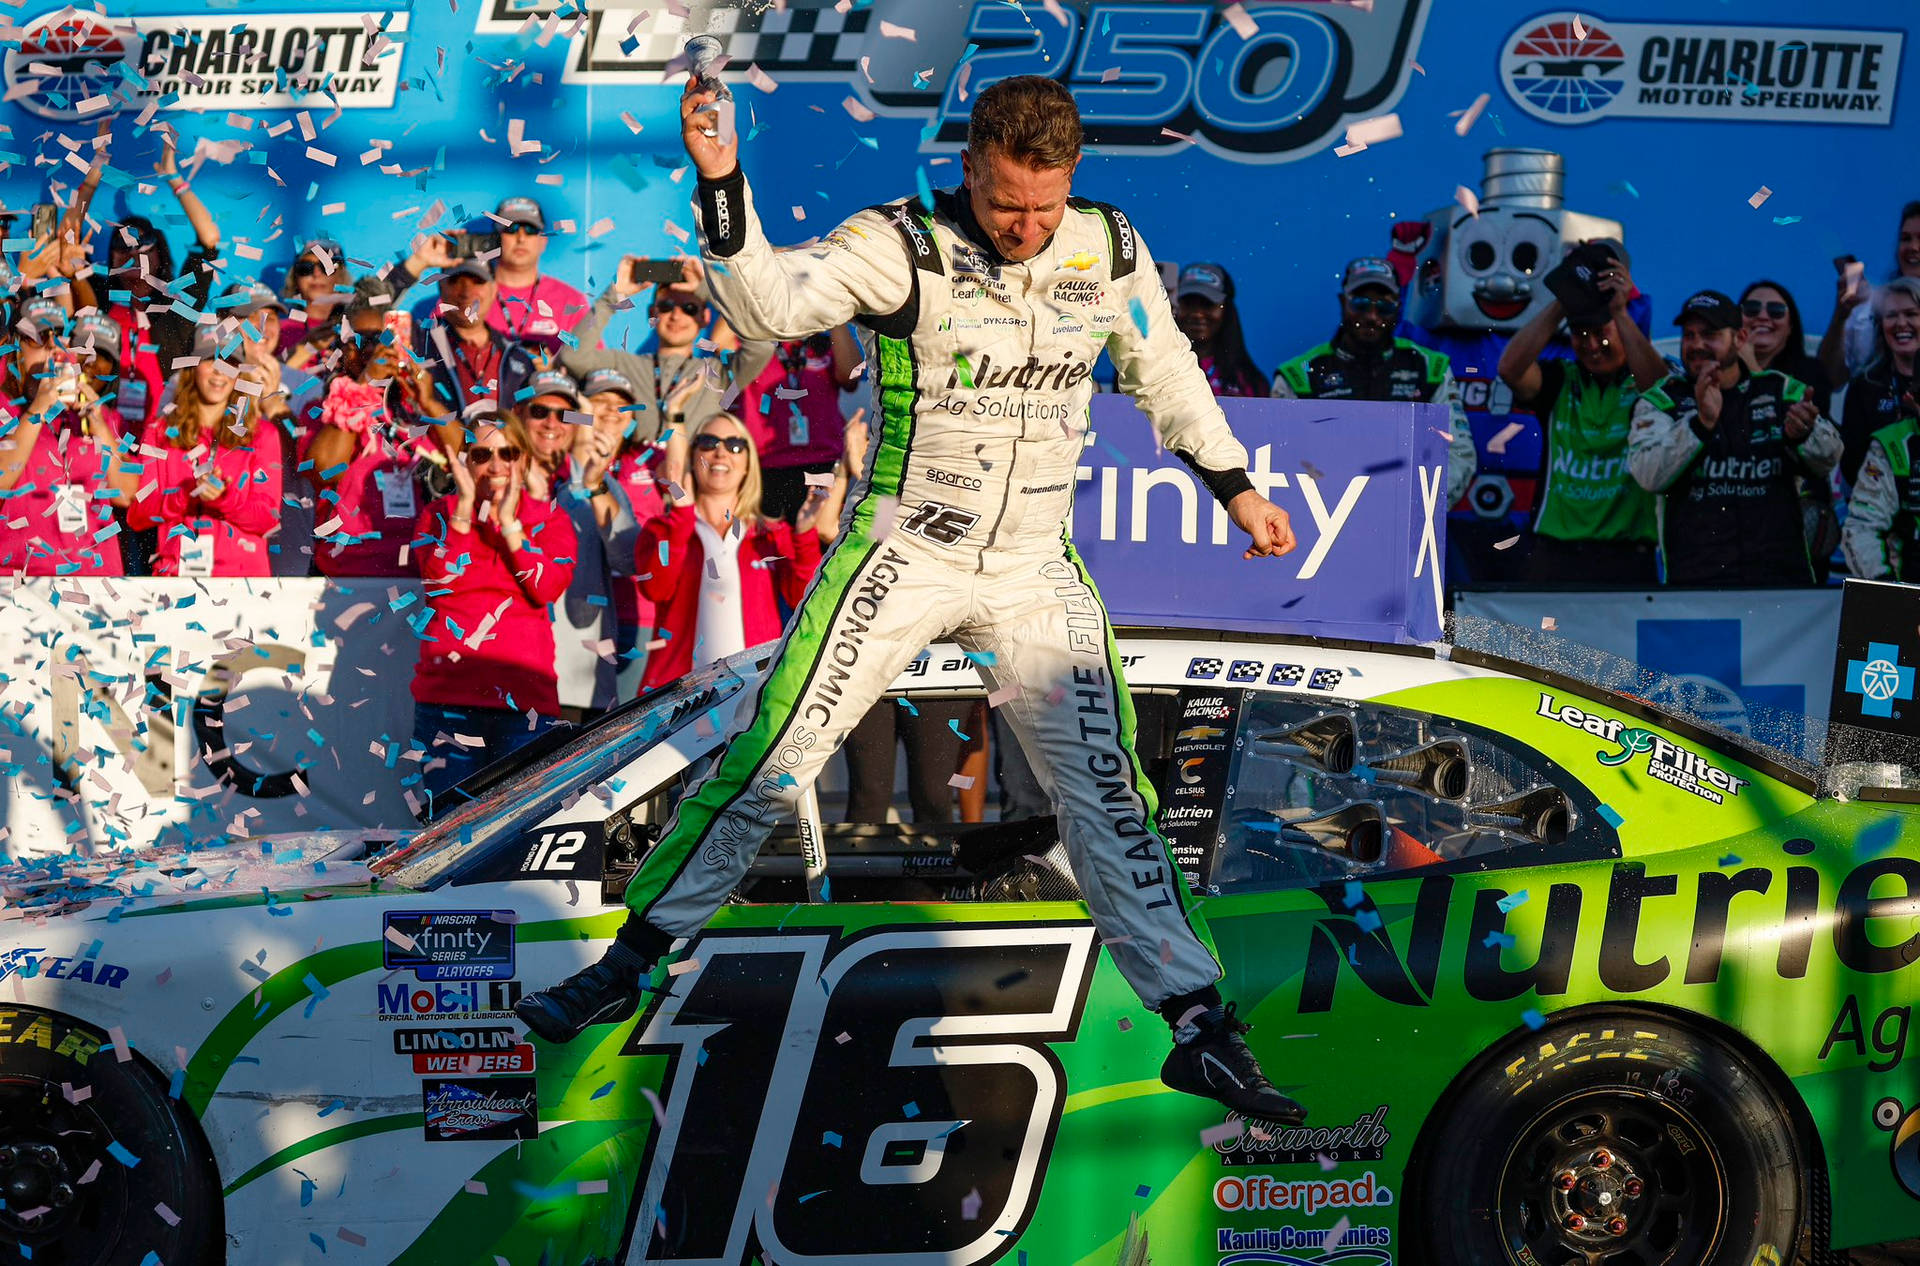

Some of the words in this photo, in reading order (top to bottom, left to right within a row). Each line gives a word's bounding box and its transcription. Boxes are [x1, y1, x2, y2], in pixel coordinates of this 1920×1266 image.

[141, 26, 381, 77] CHARLOTTE
[1637, 36, 1884, 91] CHARLOTTE
[936, 3, 1340, 132] 250
[1637, 87, 1733, 107] MOTOR
[714, 188, 731, 241] sparco
[1112, 210, 1134, 261] sparco
[951, 288, 976, 300] Leaf
[1053, 290, 1095, 303] RACING
[1055, 280, 1100, 291] KAULIG
[945, 351, 1092, 391] Nutrie
[932, 396, 968, 416] Ag
[972, 395, 1069, 420] Solutions
[926, 468, 983, 491] sparco
[900, 500, 982, 547] 16
[1038, 560, 1100, 655] FIELD
[805, 546, 909, 728] AGRONOMIC
[1072, 664, 1112, 743] THE
[1184, 707, 1219, 718] RACING
[1187, 697, 1223, 708] KAULIG
[1174, 744, 1227, 753] CHEVROLET
[1536, 692, 1626, 743] Leaf
[1651, 737, 1746, 795] Filter
[1649, 759, 1698, 784] GUTTER
[1175, 787, 1206, 796] CELSIUS
[1647, 767, 1723, 806] PROTECTION
[1161, 804, 1213, 820] Nutrien
[1168, 820, 1198, 828] Solutions
[1087, 753, 1174, 911] LEADING
[529, 830, 587, 871] 12
[1172, 847, 1204, 855] ensive
[434, 915, 478, 925] NASCAR
[406, 926, 493, 956] xfinity
[431, 951, 467, 961] SERIES
[436, 965, 495, 978] PLAYOFFS
[377, 981, 479, 1014] Mobil
[378, 1014, 414, 1022] OFFICIAL
[416, 1013, 446, 1021] MOTOR
[471, 1011, 520, 1020] LUBRICANT
[1817, 994, 1912, 1073] Ag
[1504, 1029, 1660, 1097] EAGLE
[425, 1090, 531, 1113] Arrowhead
[619, 922, 1098, 1266] 16
[445, 1110, 491, 1126] Brass
[1223, 1149, 1382, 1165] ADVISORS
[1214, 1172, 1376, 1215] Offerpad
[1217, 1225, 1391, 1252] KauligComanies
